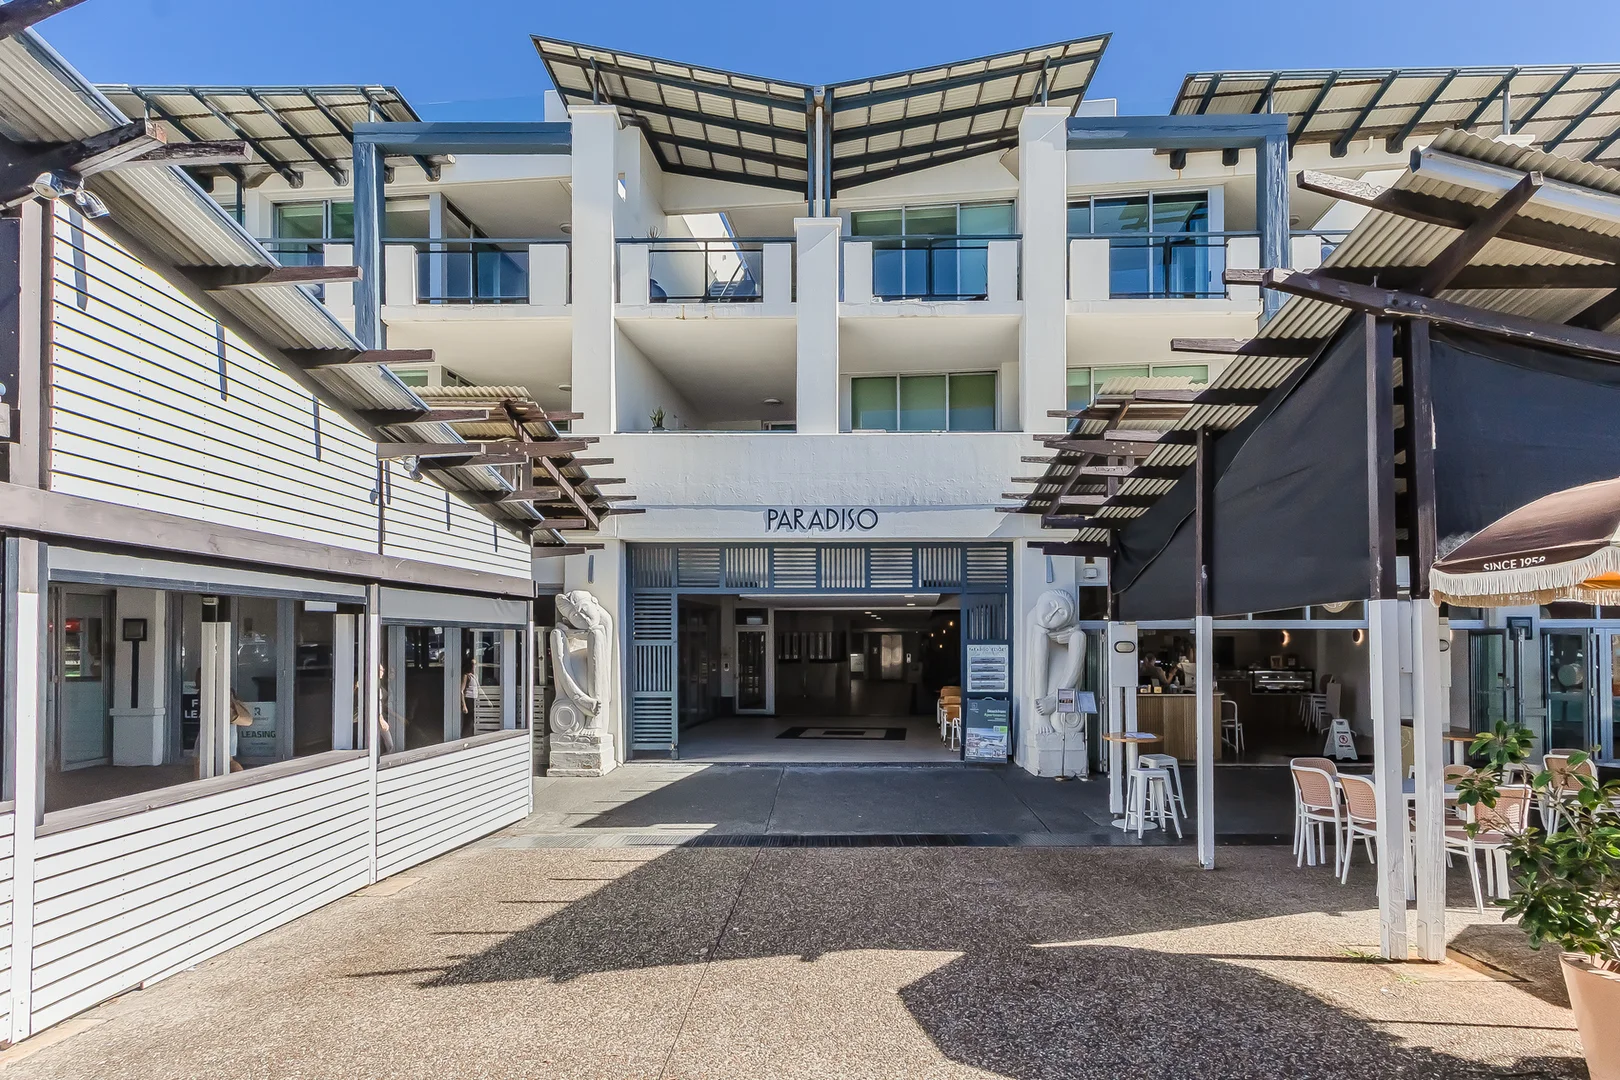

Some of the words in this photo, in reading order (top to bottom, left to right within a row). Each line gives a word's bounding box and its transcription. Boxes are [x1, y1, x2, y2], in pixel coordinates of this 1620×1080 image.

[767, 508, 878, 530] PARADISO
[1483, 559, 1517, 571] SINCE
[241, 730, 276, 739] LEASING
